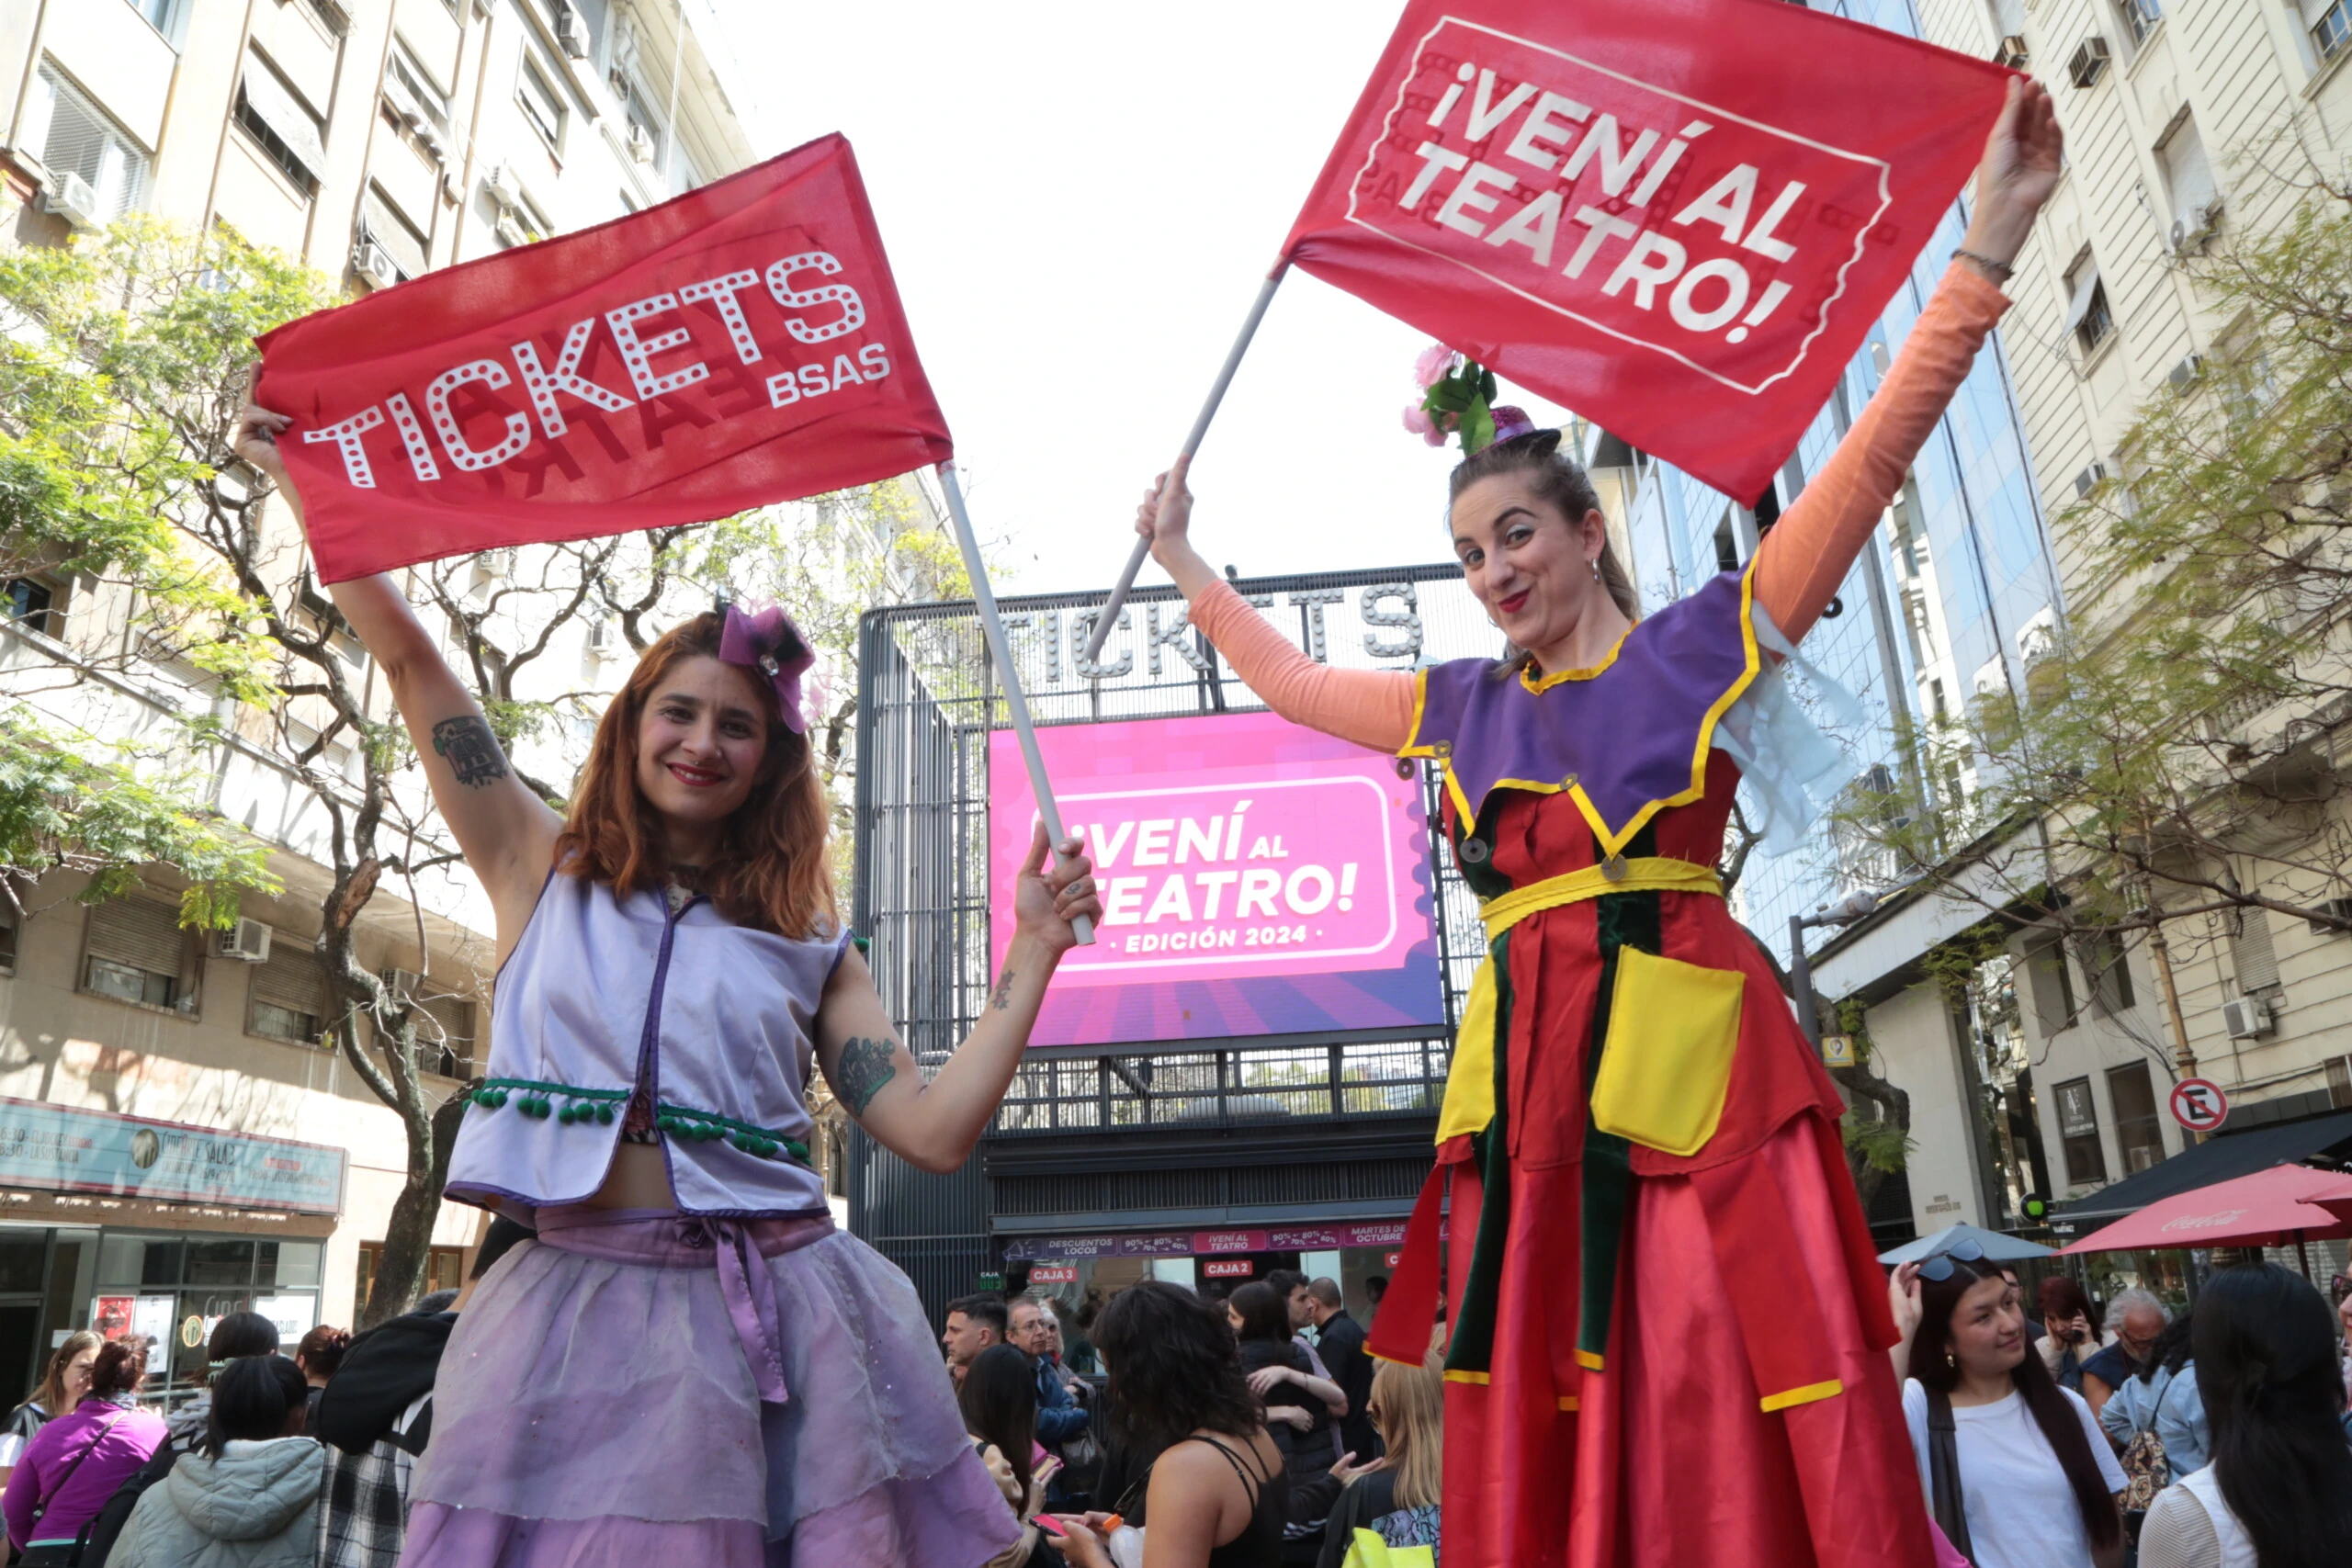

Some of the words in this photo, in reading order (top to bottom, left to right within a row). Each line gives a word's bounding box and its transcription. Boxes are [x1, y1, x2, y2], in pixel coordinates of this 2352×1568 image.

[1427, 62, 1714, 208] ¡VENÍ
[1672, 164, 1807, 264] AL
[1398, 141, 1793, 344] TEATRO!
[303, 251, 866, 489] TICKETS
[764, 343, 891, 409] BSAS
[975, 581, 1423, 682] ICKTS
[1248, 835, 1289, 861] AL
[1093, 863, 1359, 926] EATRO!
[1125, 925, 1236, 953] EDICIÓN
[1244, 924, 1307, 947] 2024
[2184, 1088, 2215, 1121] E
[1351, 1225, 1391, 1235] MARTES
[1392, 1224, 1407, 1233] DE
[1125, 1237, 1144, 1247] 90%
[1154, 1236, 1172, 1246] 80%
[1236, 1234, 1249, 1242] AL
[1272, 1232, 1291, 1242] 90%
[1302, 1230, 1320, 1240] 80%
[1356, 1232, 1402, 1243] OCTUBRE
[1048, 1238, 1113, 1248] DESCUENTOS
[1210, 1241, 1249, 1251] TEATRO
[1064, 1247, 1097, 1256] LOCOS
[1034, 1269, 1065, 1280] CAJA
[1066, 1269, 1074, 1280] 3
[1208, 1264, 1238, 1274] CAJA
[1240, 1263, 1249, 1273] 2
